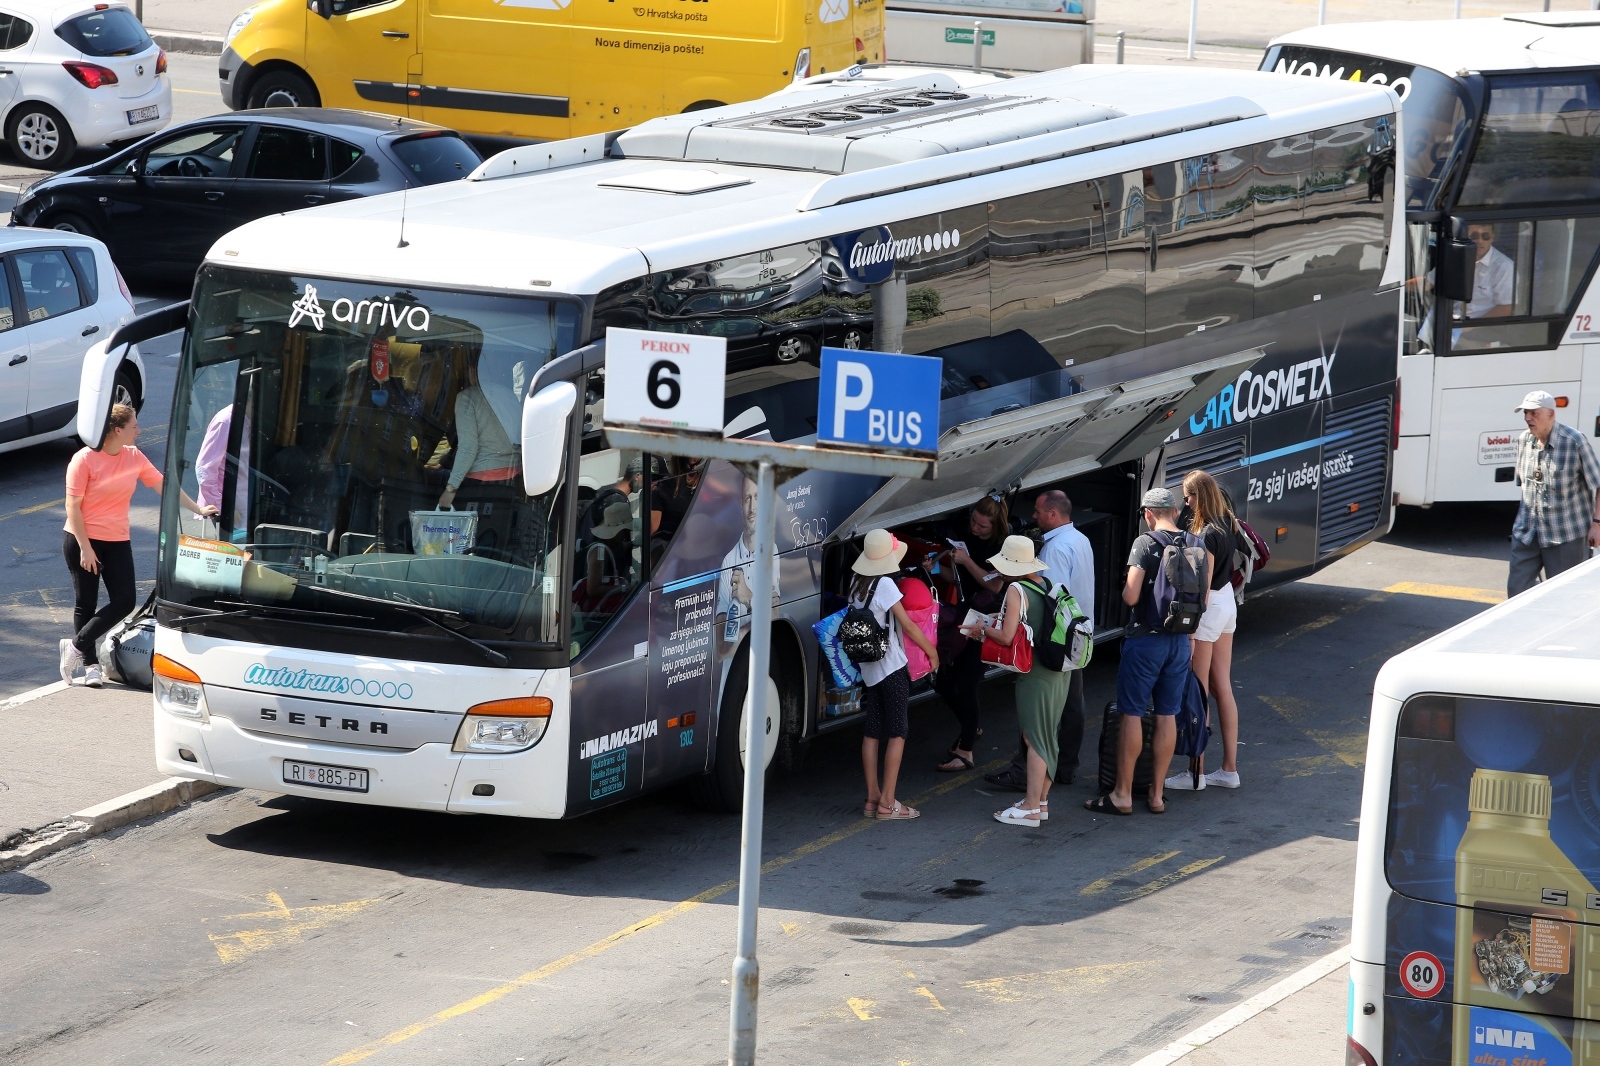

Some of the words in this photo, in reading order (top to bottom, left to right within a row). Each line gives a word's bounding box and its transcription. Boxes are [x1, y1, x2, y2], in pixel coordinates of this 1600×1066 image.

[646, 8, 683, 20] Hrvatska
[684, 12, 708, 22] pošta
[595, 37, 620, 48] Nova
[623, 40, 670, 53] dimenzija
[673, 44, 704, 54] pošte!
[331, 295, 430, 332] arriva
[1575, 314, 1592, 332] 72
[641, 339, 690, 354] PERON
[647, 359, 681, 410] 6
[833, 360, 874, 439] P
[868, 408, 922, 446] BUS
[1487, 434, 1511, 446] brioni
[1248, 478, 1262, 502] Za
[1265, 468, 1286, 503] sjaj
[1288, 462, 1320, 490] vašeg
[423, 525, 447, 533] Thermo
[449, 526, 460, 534] Bag
[179, 549, 201, 560] ZAGREB
[225, 557, 242, 567] PULA
[675, 594, 700, 609] Premium
[684, 604, 712, 624] proizvoda
[670, 632, 678, 641] za
[662, 643, 685, 658] limenog
[685, 636, 709, 653] ljubimca
[662, 661, 674, 674] koju
[260, 708, 388, 735] SETRA
[680, 729, 694, 748] 1302
[292, 765, 305, 780] RI
[318, 768, 363, 787] 885-PI
[1412, 965, 1433, 984] 80
[1474, 1052, 1507, 1066] ultra
